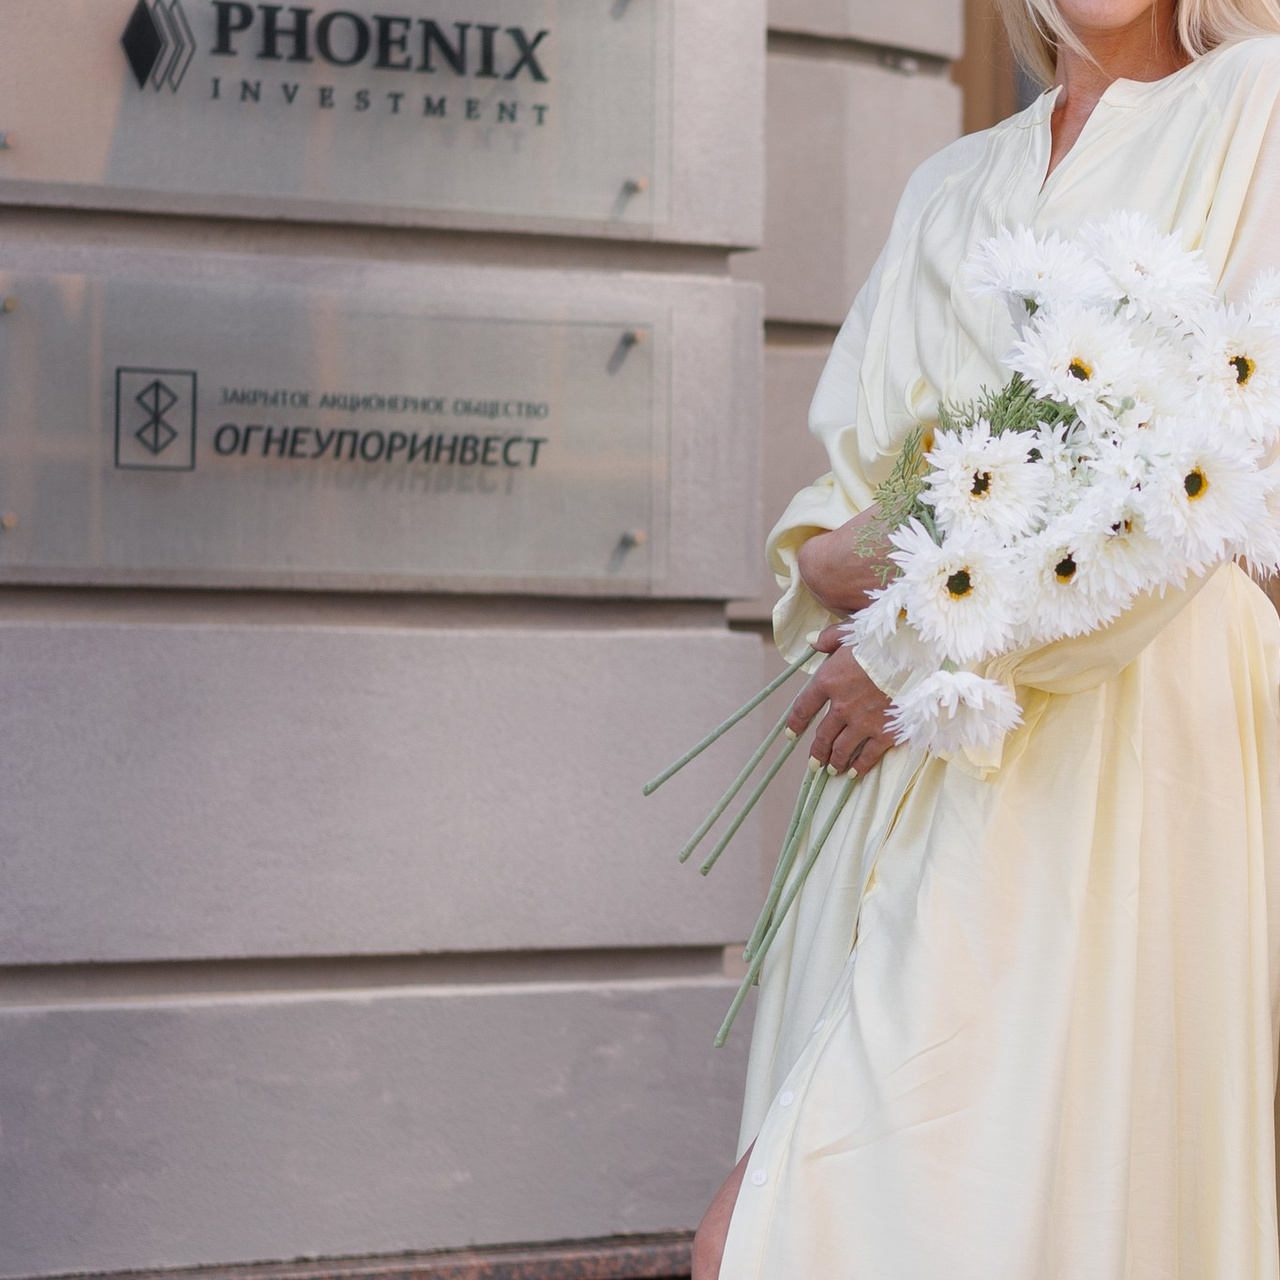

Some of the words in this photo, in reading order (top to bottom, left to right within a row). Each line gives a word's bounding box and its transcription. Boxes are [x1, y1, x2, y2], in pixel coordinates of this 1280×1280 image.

[209, 0, 550, 83] PHOENIX
[210, 77, 549, 126] INVESTMENT
[213, 423, 549, 468] ОГНЕУПОРИНВЕСТ
